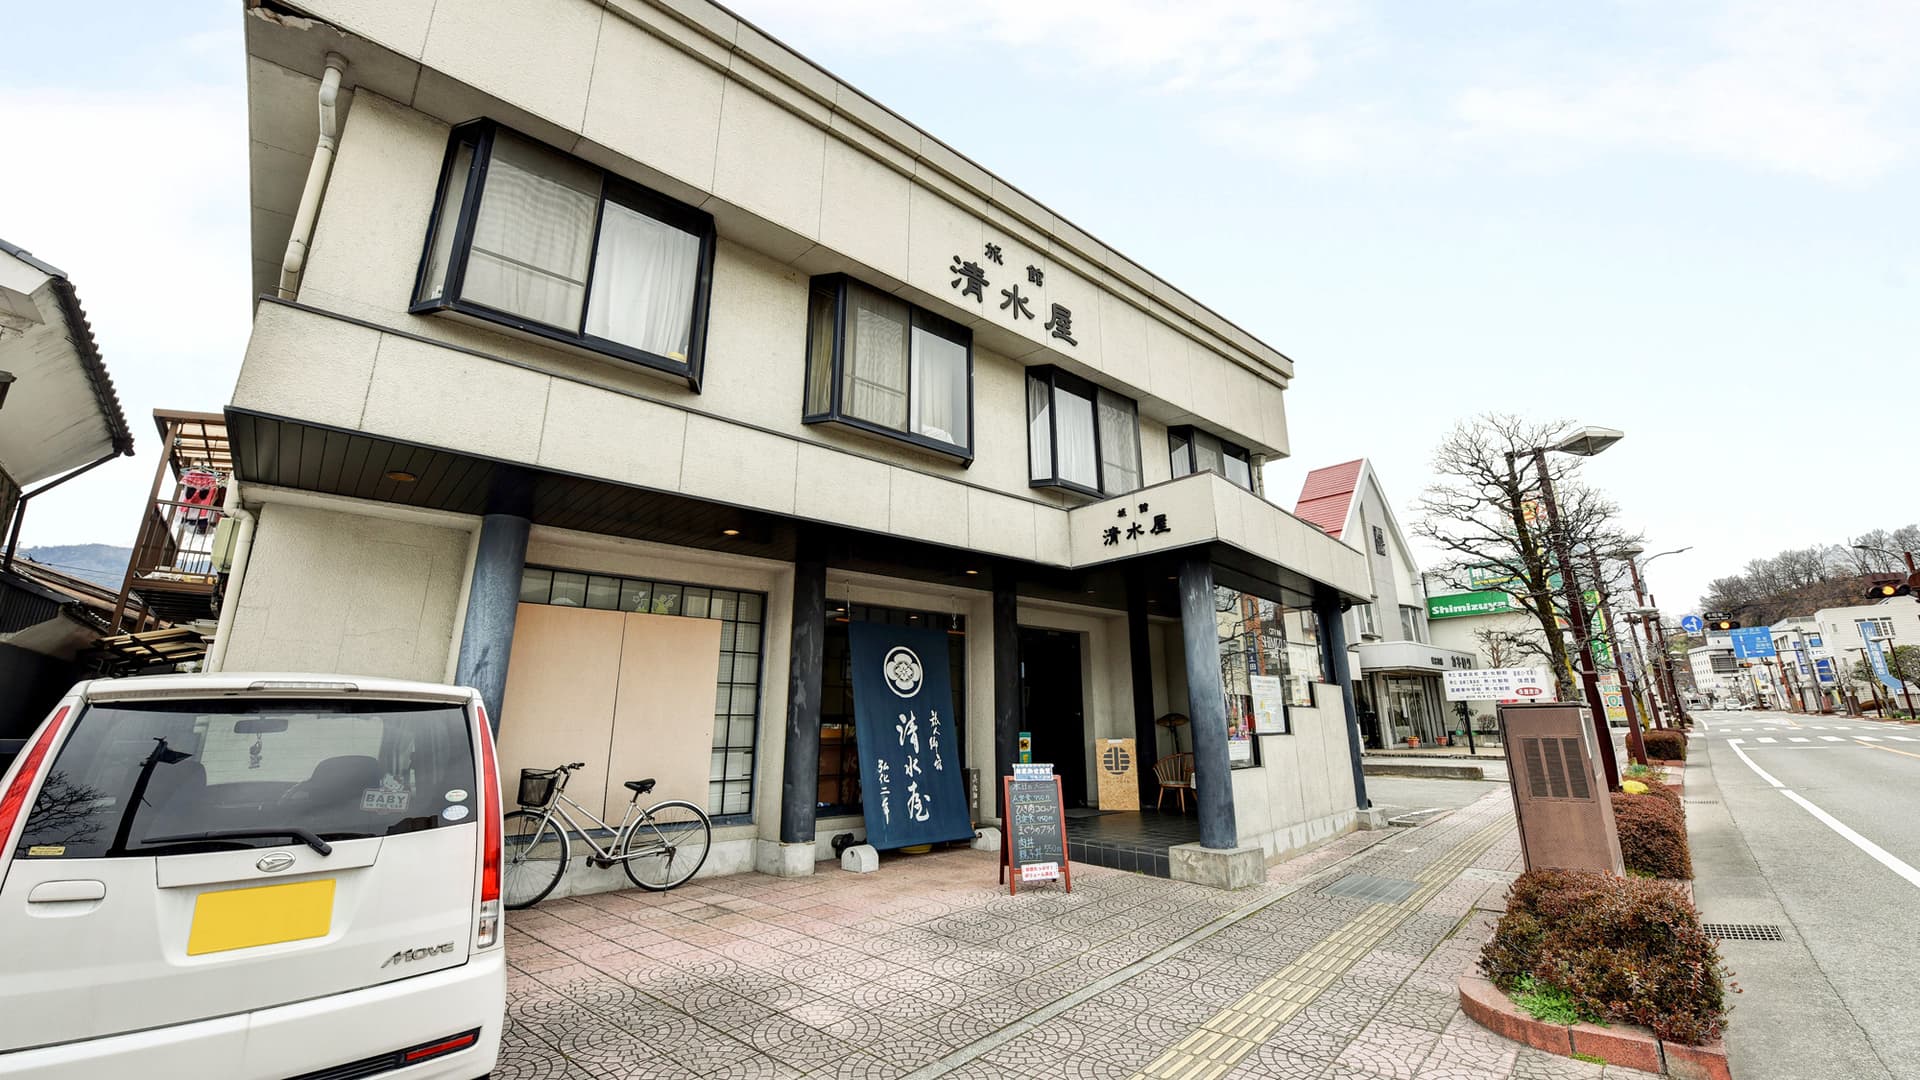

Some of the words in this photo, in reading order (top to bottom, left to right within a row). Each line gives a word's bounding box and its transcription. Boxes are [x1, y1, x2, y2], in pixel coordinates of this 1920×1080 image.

[984, 242, 1045, 287] 旅館
[950, 255, 1078, 347] 清水屋
[1103, 514, 1171, 546] 清水屋
[1432, 600, 1507, 615] Shimizuya
[896, 710, 931, 822] 清水屋
[365, 794, 406, 804] BABY
[877, 759, 891, 825] 弘化二年
[381, 940, 455, 968] MOVE
